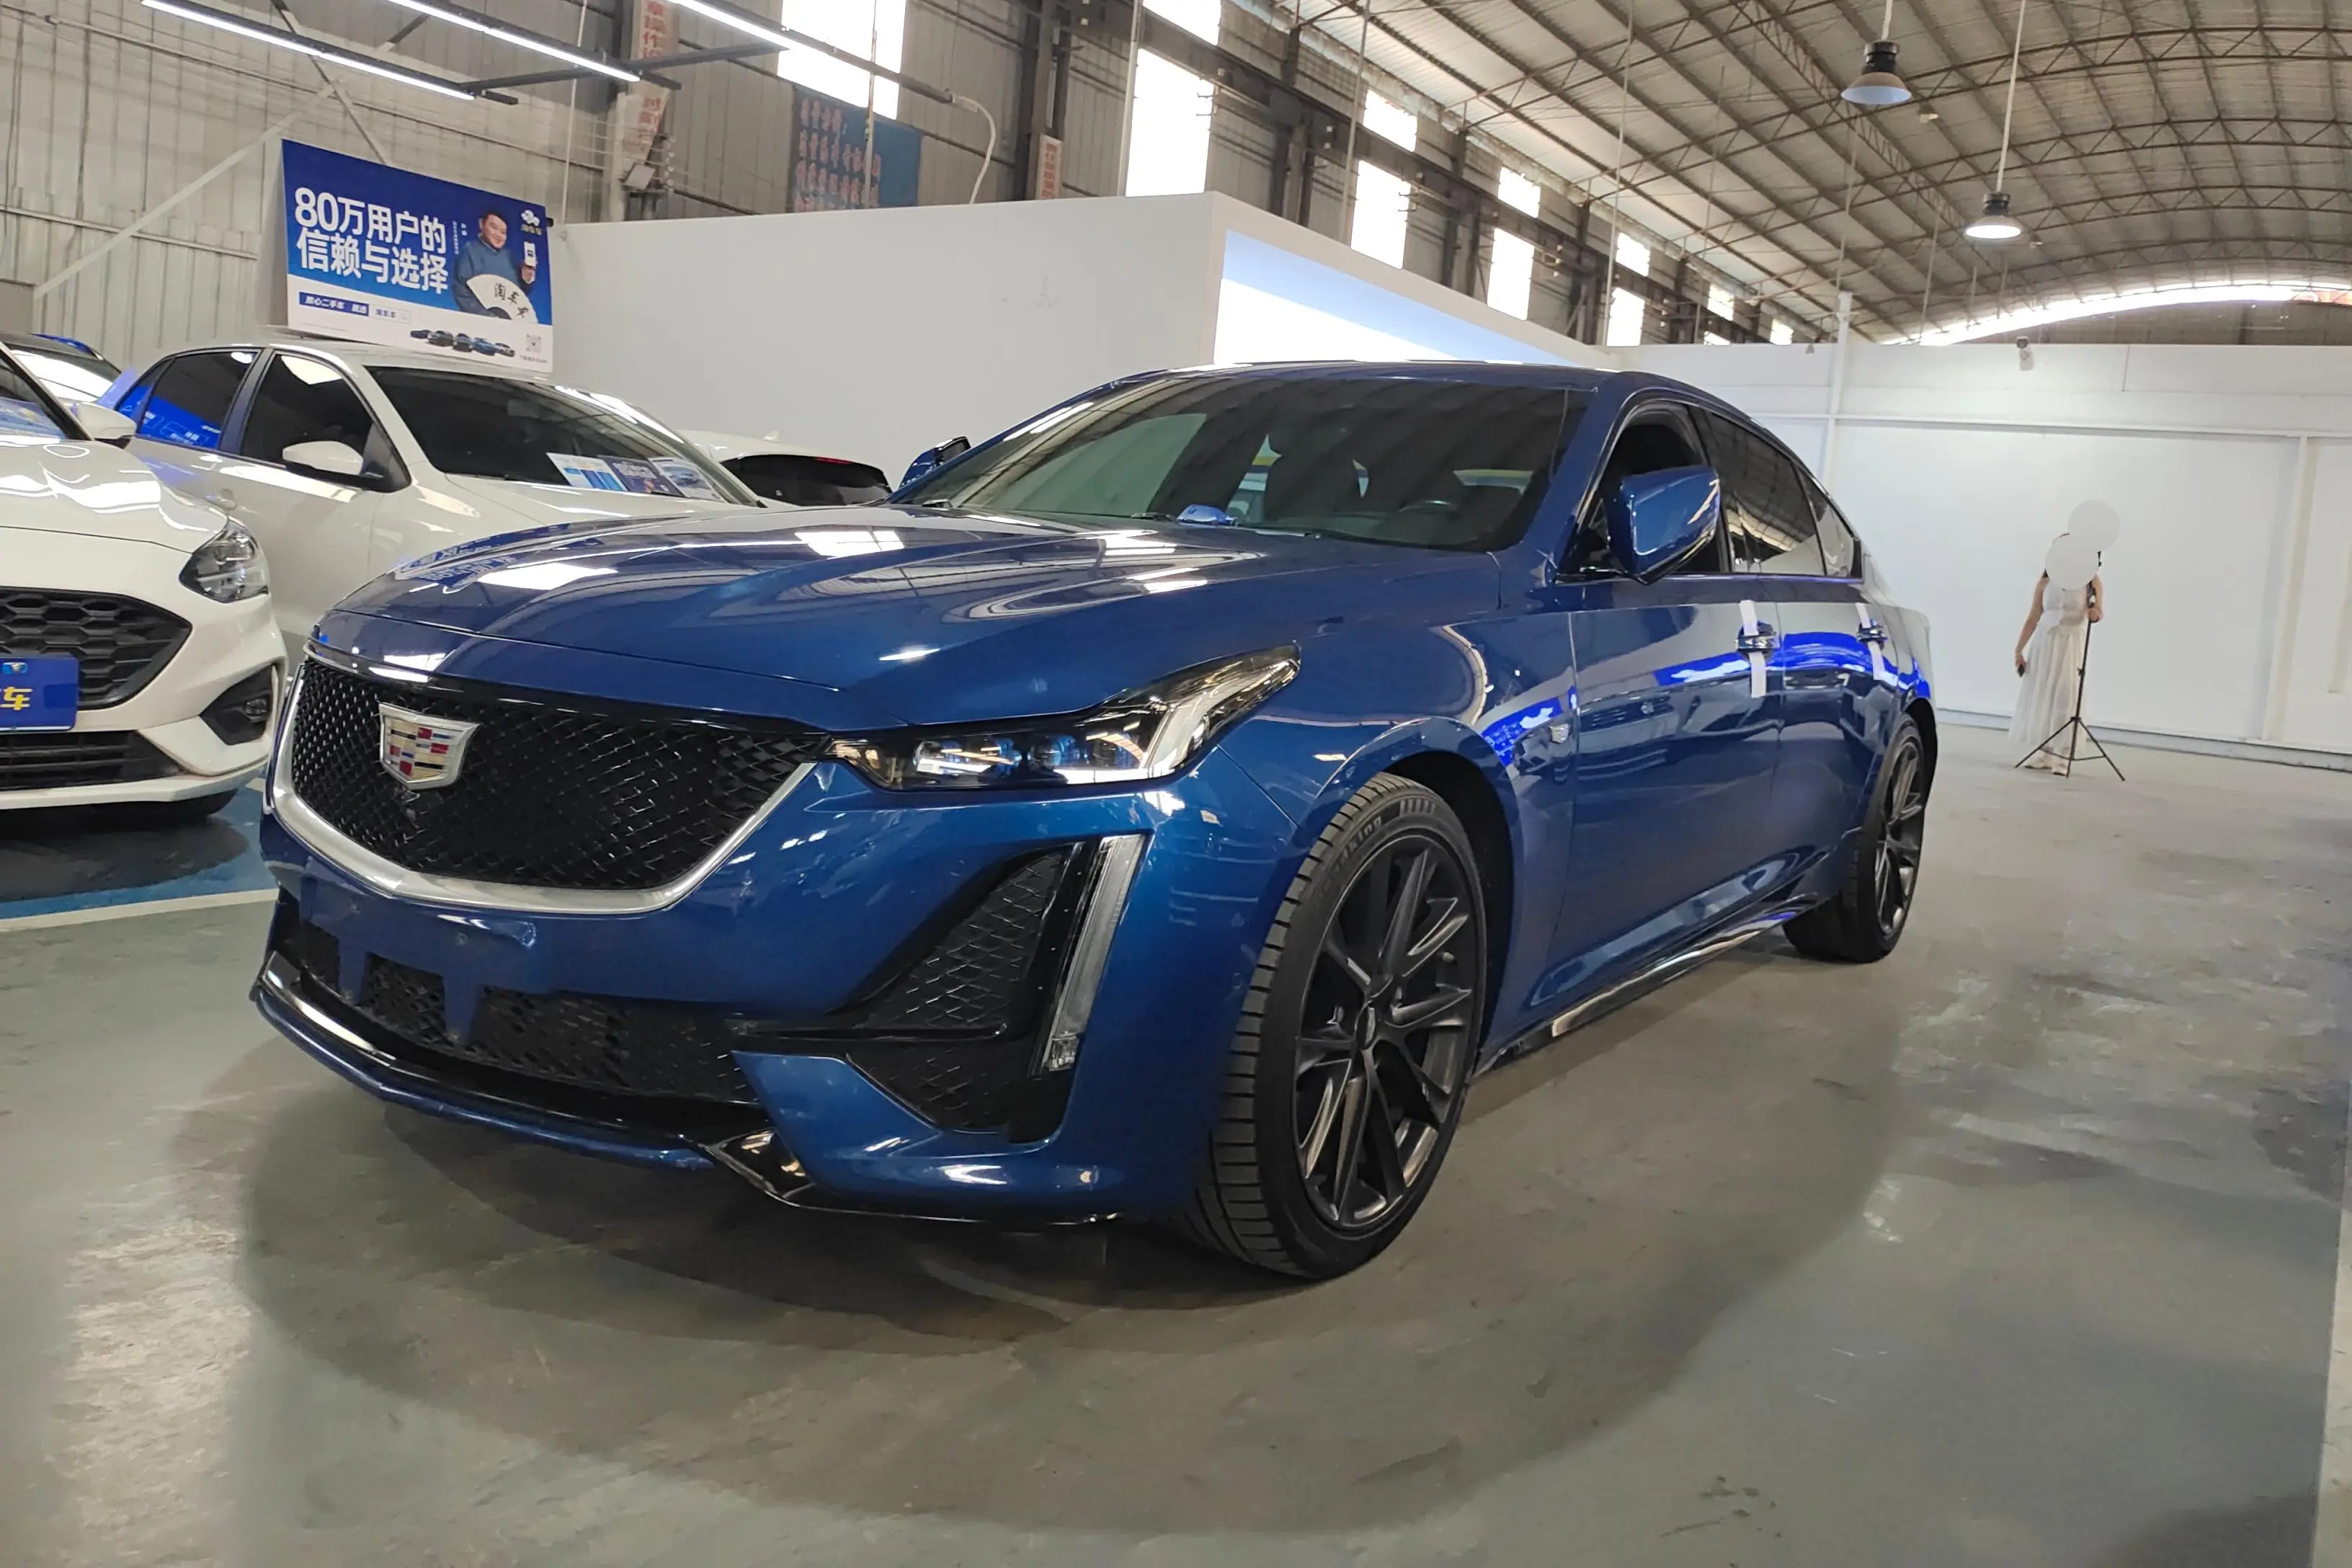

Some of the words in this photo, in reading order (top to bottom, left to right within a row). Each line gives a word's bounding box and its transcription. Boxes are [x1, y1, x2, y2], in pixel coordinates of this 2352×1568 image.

[295, 187, 447, 254] 80万用户的
[296, 227, 448, 294] 信赖与选择
